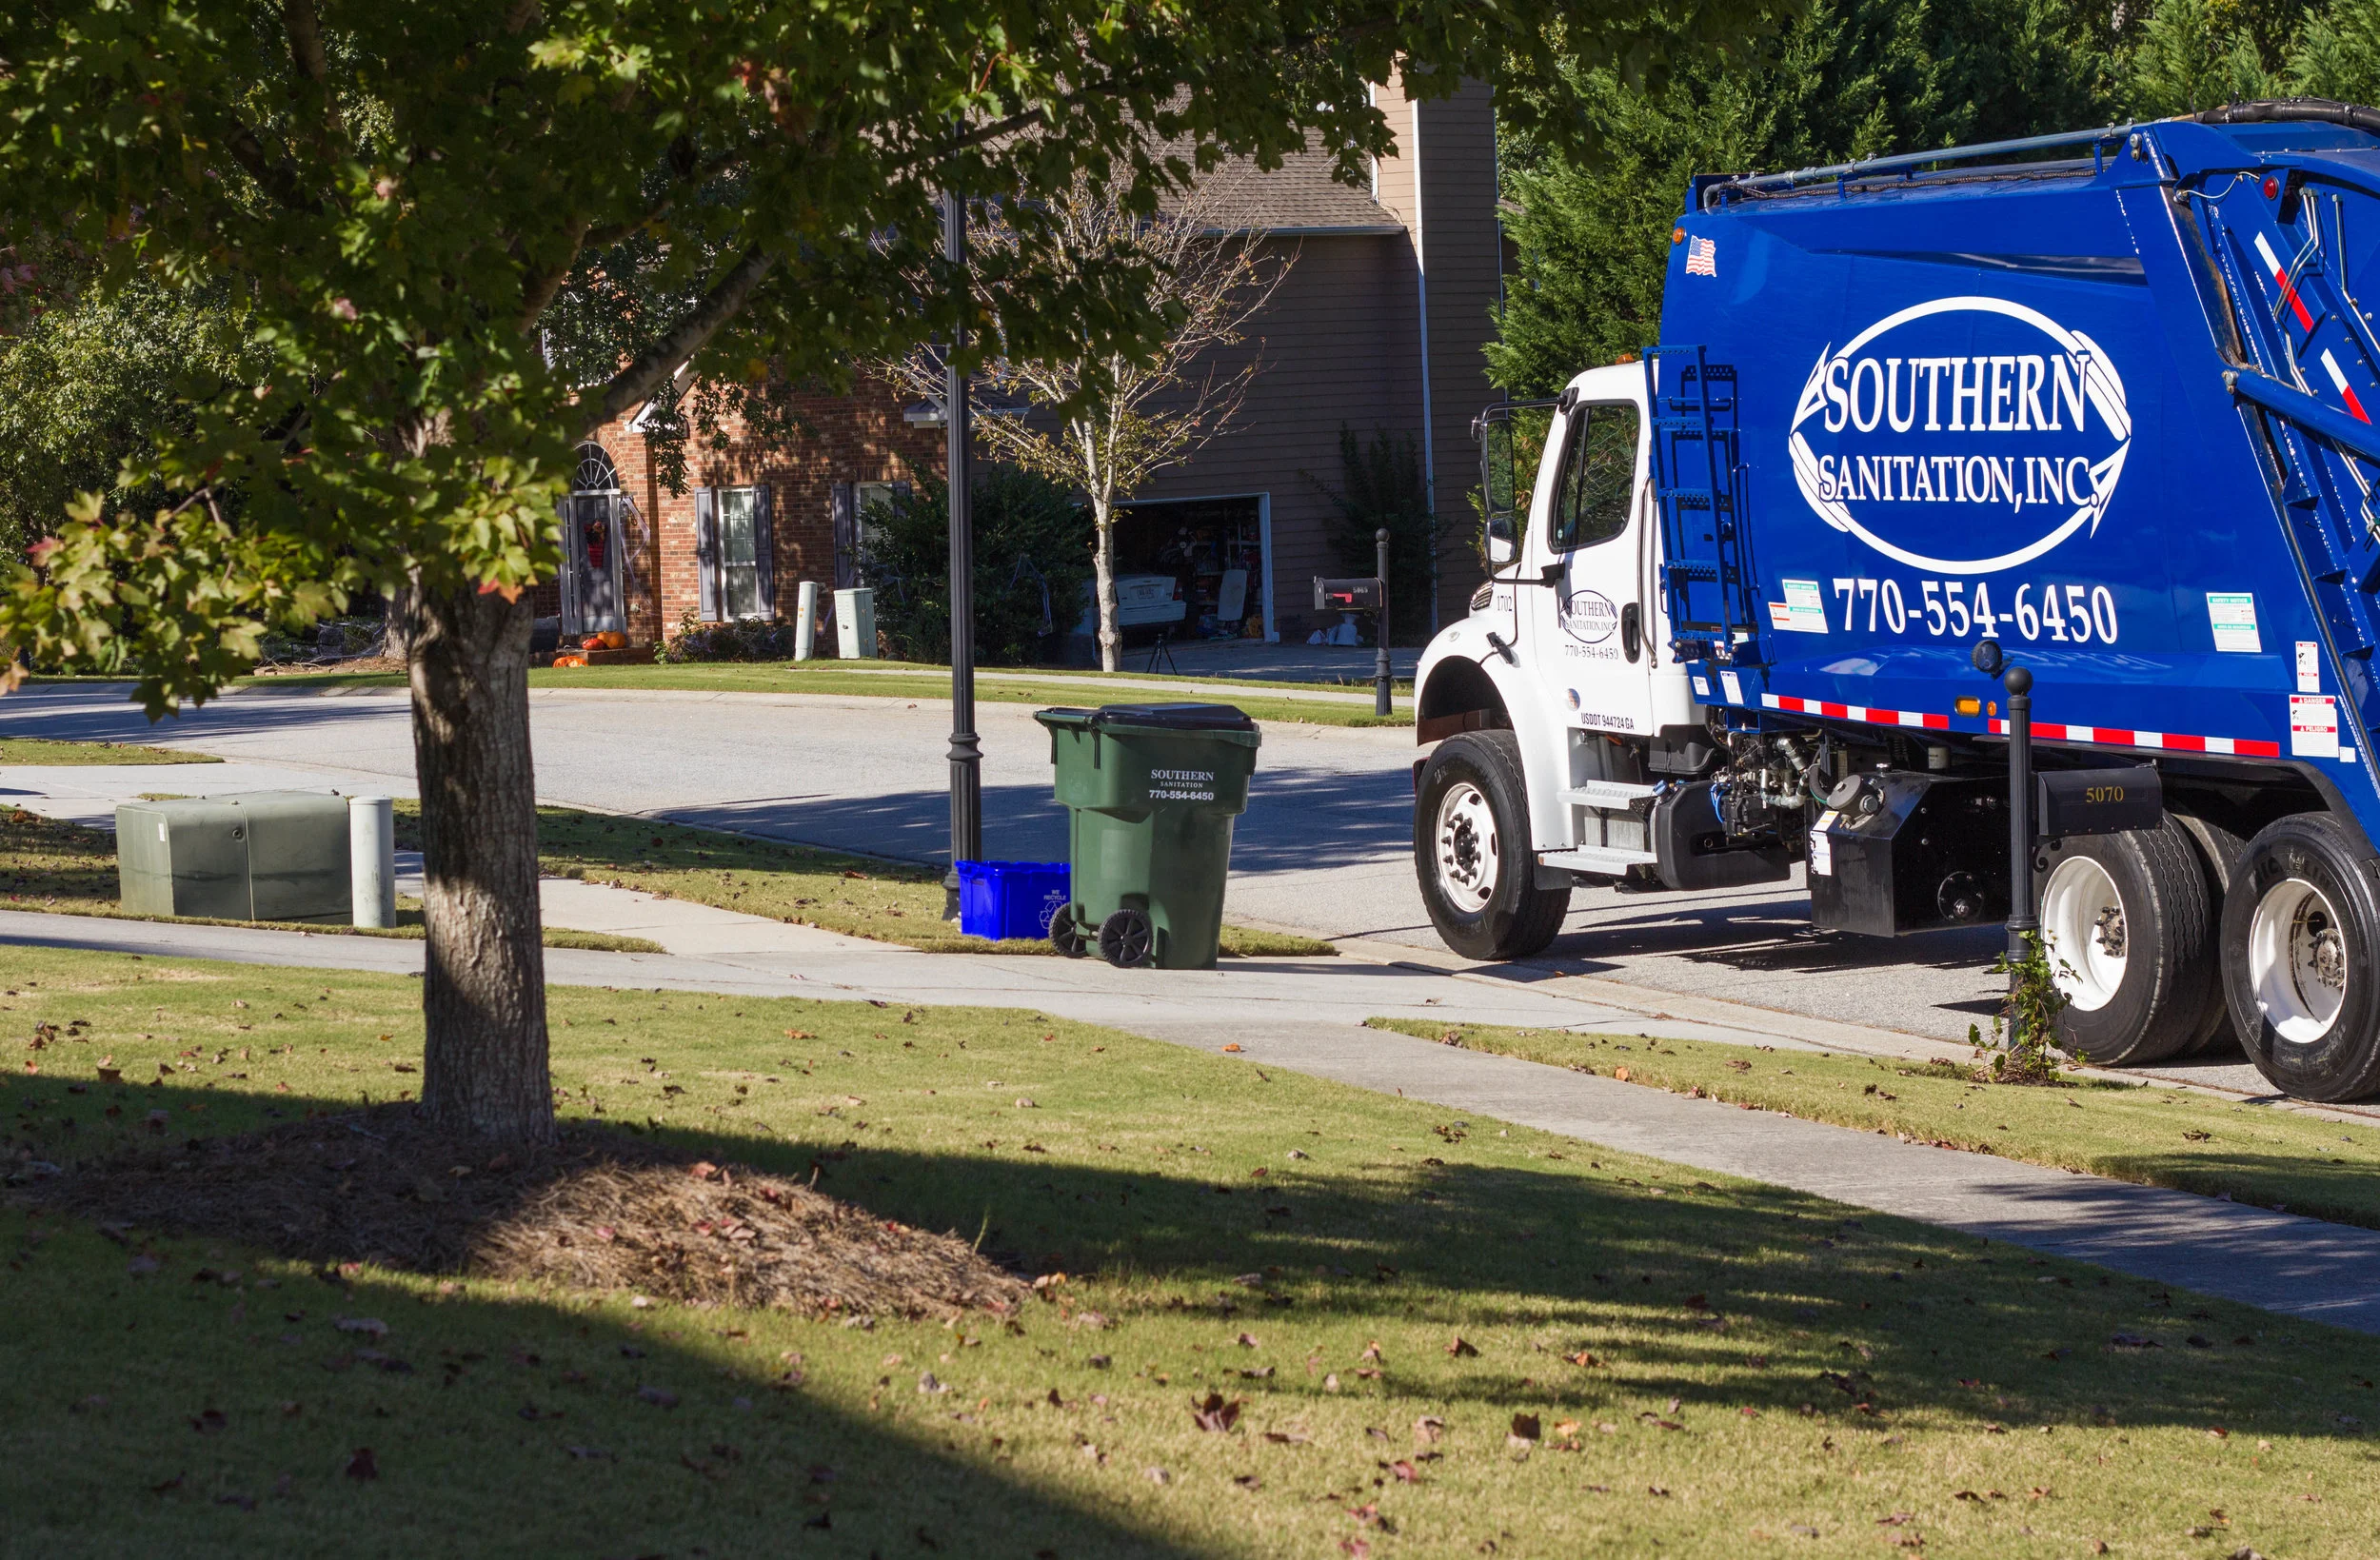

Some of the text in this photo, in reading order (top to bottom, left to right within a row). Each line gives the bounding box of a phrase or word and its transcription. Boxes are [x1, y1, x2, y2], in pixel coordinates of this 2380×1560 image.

[1824, 350, 2092, 433] SOUTHERN
[1497, 595, 1513, 612] 1702
[1566, 600, 1613, 617] SOUTHERN
[1833, 579, 2118, 644] 770-554-6450
[1580, 712, 1635, 730] USDOT 944724 GA
[1150, 769, 1214, 781] SOUTHERN
[1149, 789, 1214, 800] 770-554-6450
[2086, 786, 2124, 802] 5070
